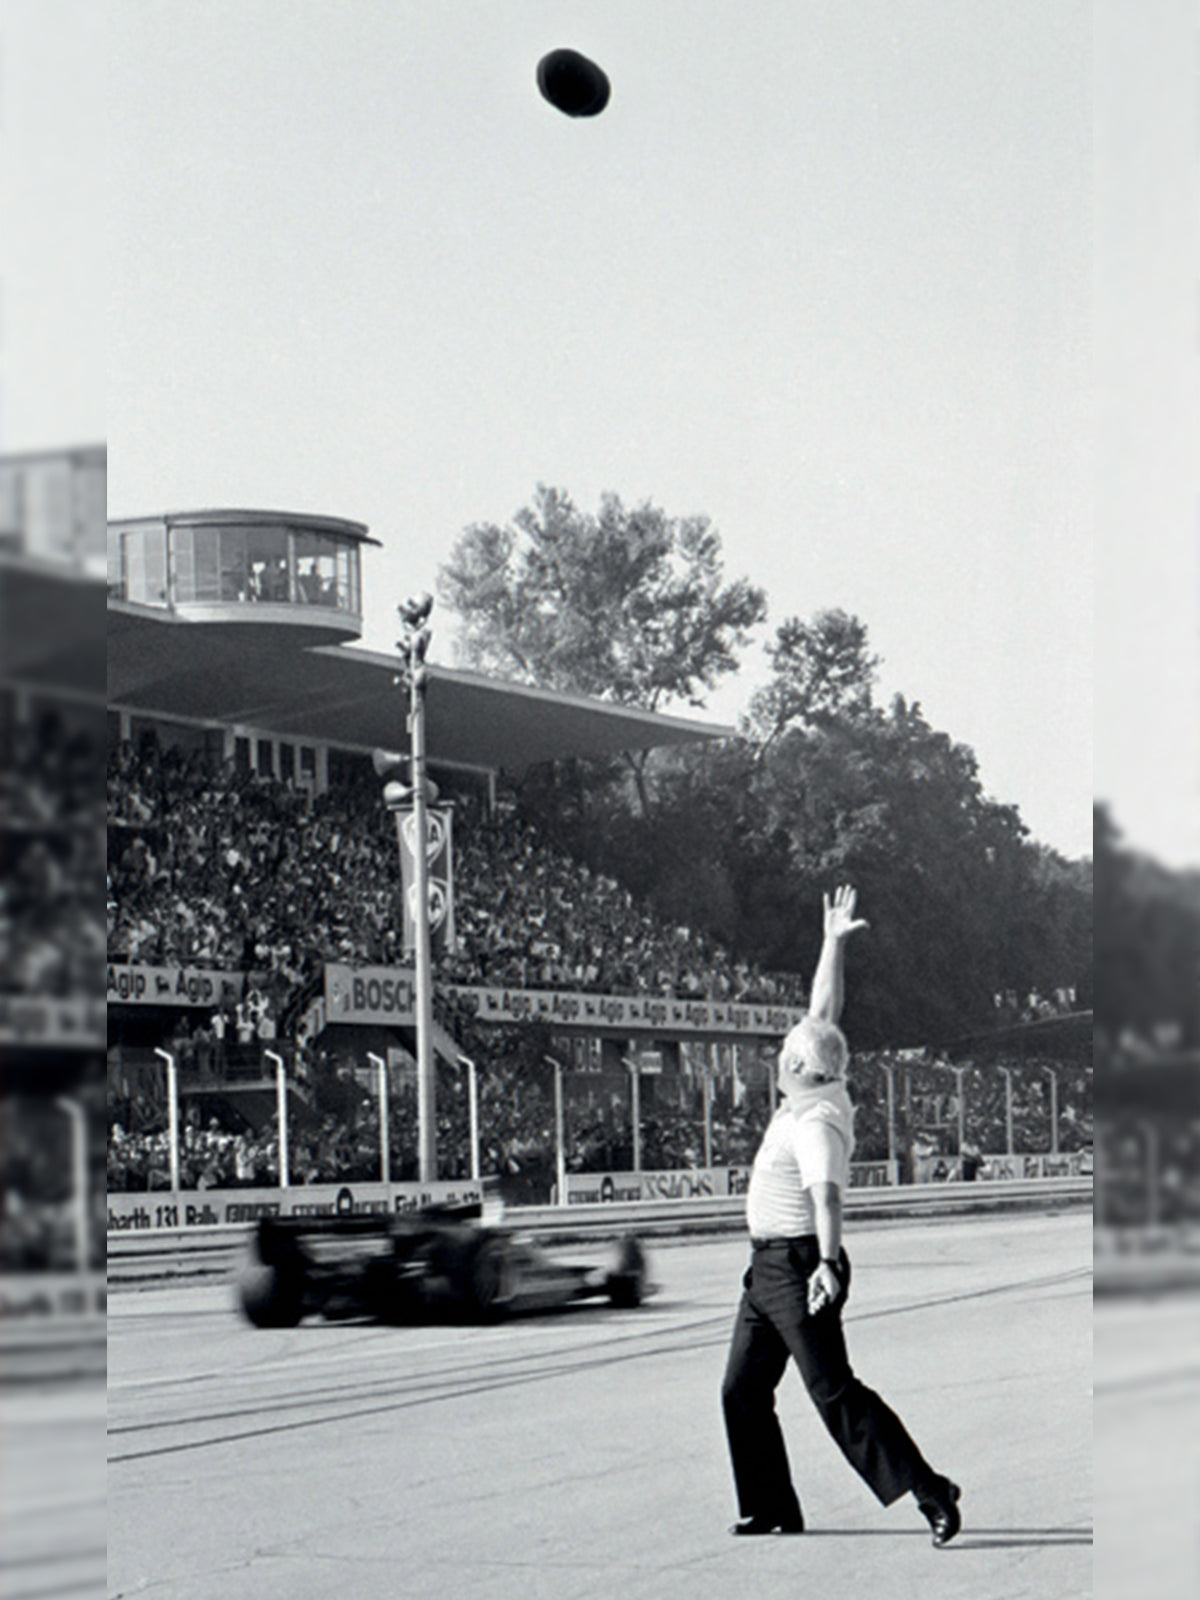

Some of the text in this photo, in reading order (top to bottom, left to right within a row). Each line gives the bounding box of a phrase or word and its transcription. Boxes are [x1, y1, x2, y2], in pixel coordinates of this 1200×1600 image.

[107, 965, 213, 1003] Agip Agip
[502, 991, 531, 1019] Agip
[552, 994, 579, 1021] Agip
[599, 997, 625, 1024] Agip
[643, 1000, 668, 1026] Agip
[685, 1003, 708, 1028] Agip
[726, 1005, 750, 1029] Agip
[766, 1008, 788, 1032] Agip
[656, 1173, 713, 1198] SACHS
[107, 1207, 150, 1230] barth
[156, 1205, 178, 1228] 131
